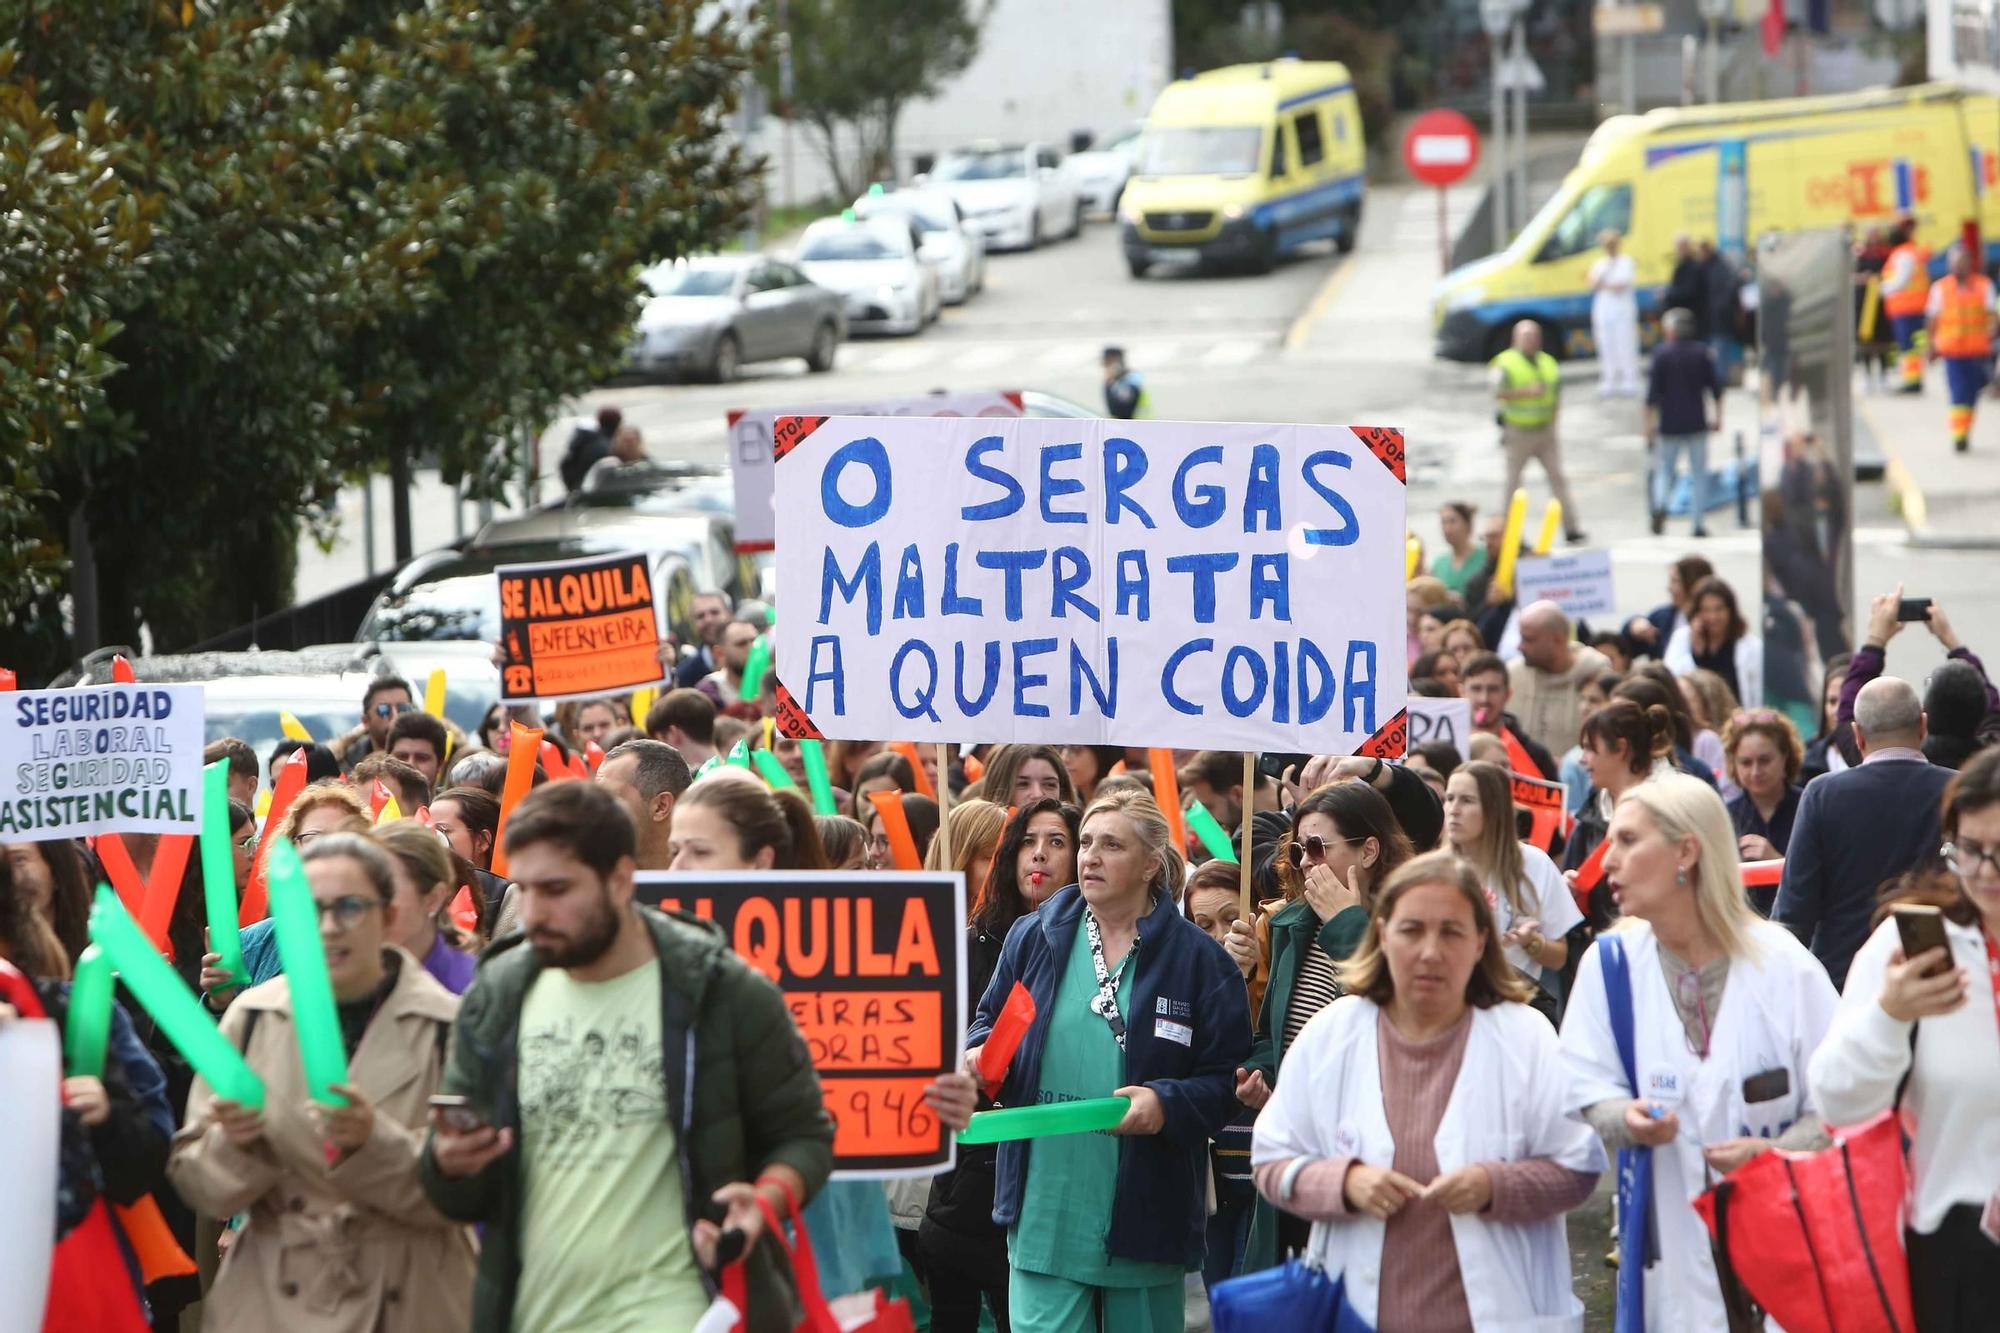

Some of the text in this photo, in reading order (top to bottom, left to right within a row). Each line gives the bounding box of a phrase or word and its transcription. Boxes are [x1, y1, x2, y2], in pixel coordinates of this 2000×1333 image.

[1371, 427, 1404, 461] STOP
[821, 437, 892, 528] O
[961, 436, 1360, 546] SERGAS
[501, 564, 651, 619] SE ALQUILA
[816, 540, 1291, 636] MALTRATA
[532, 617, 647, 654] ENFERMEIRA
[805, 635, 1376, 734] A QUEN COIDA
[776, 702, 807, 737] STOP
[1375, 723, 1406, 758] STOP
[32, 726, 172, 760] LABORAL
[659, 896, 941, 983] QUILA
